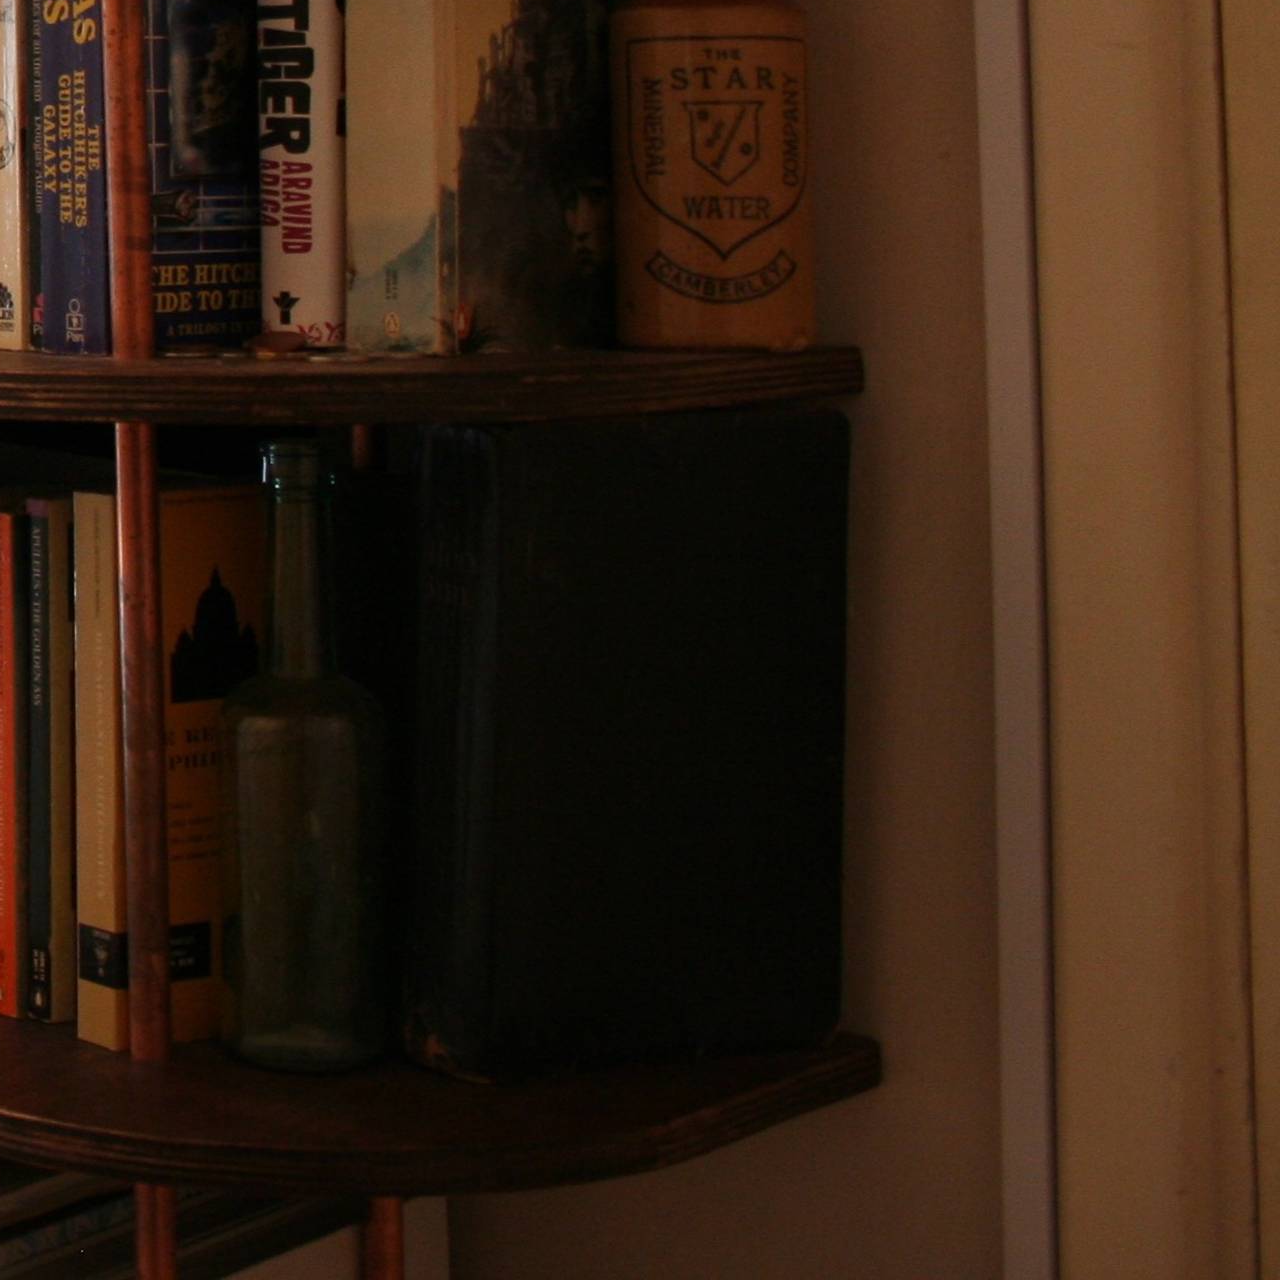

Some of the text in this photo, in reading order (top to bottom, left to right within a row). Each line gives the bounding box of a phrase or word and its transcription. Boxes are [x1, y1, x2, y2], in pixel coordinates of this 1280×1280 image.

[702, 48, 743, 61] THE
[670, 67, 775, 89] STAR
[43, 105, 57, 193] GALAXY
[58, 73, 73, 224] GUIDE TO THE
[88, 125, 100, 169] THE
[643, 78, 668, 183] MINERAL
[781, 72, 800, 187] COMPANY
[682, 197, 772, 221] WATER
[654, 264, 788, 309] CAMBERLEY
